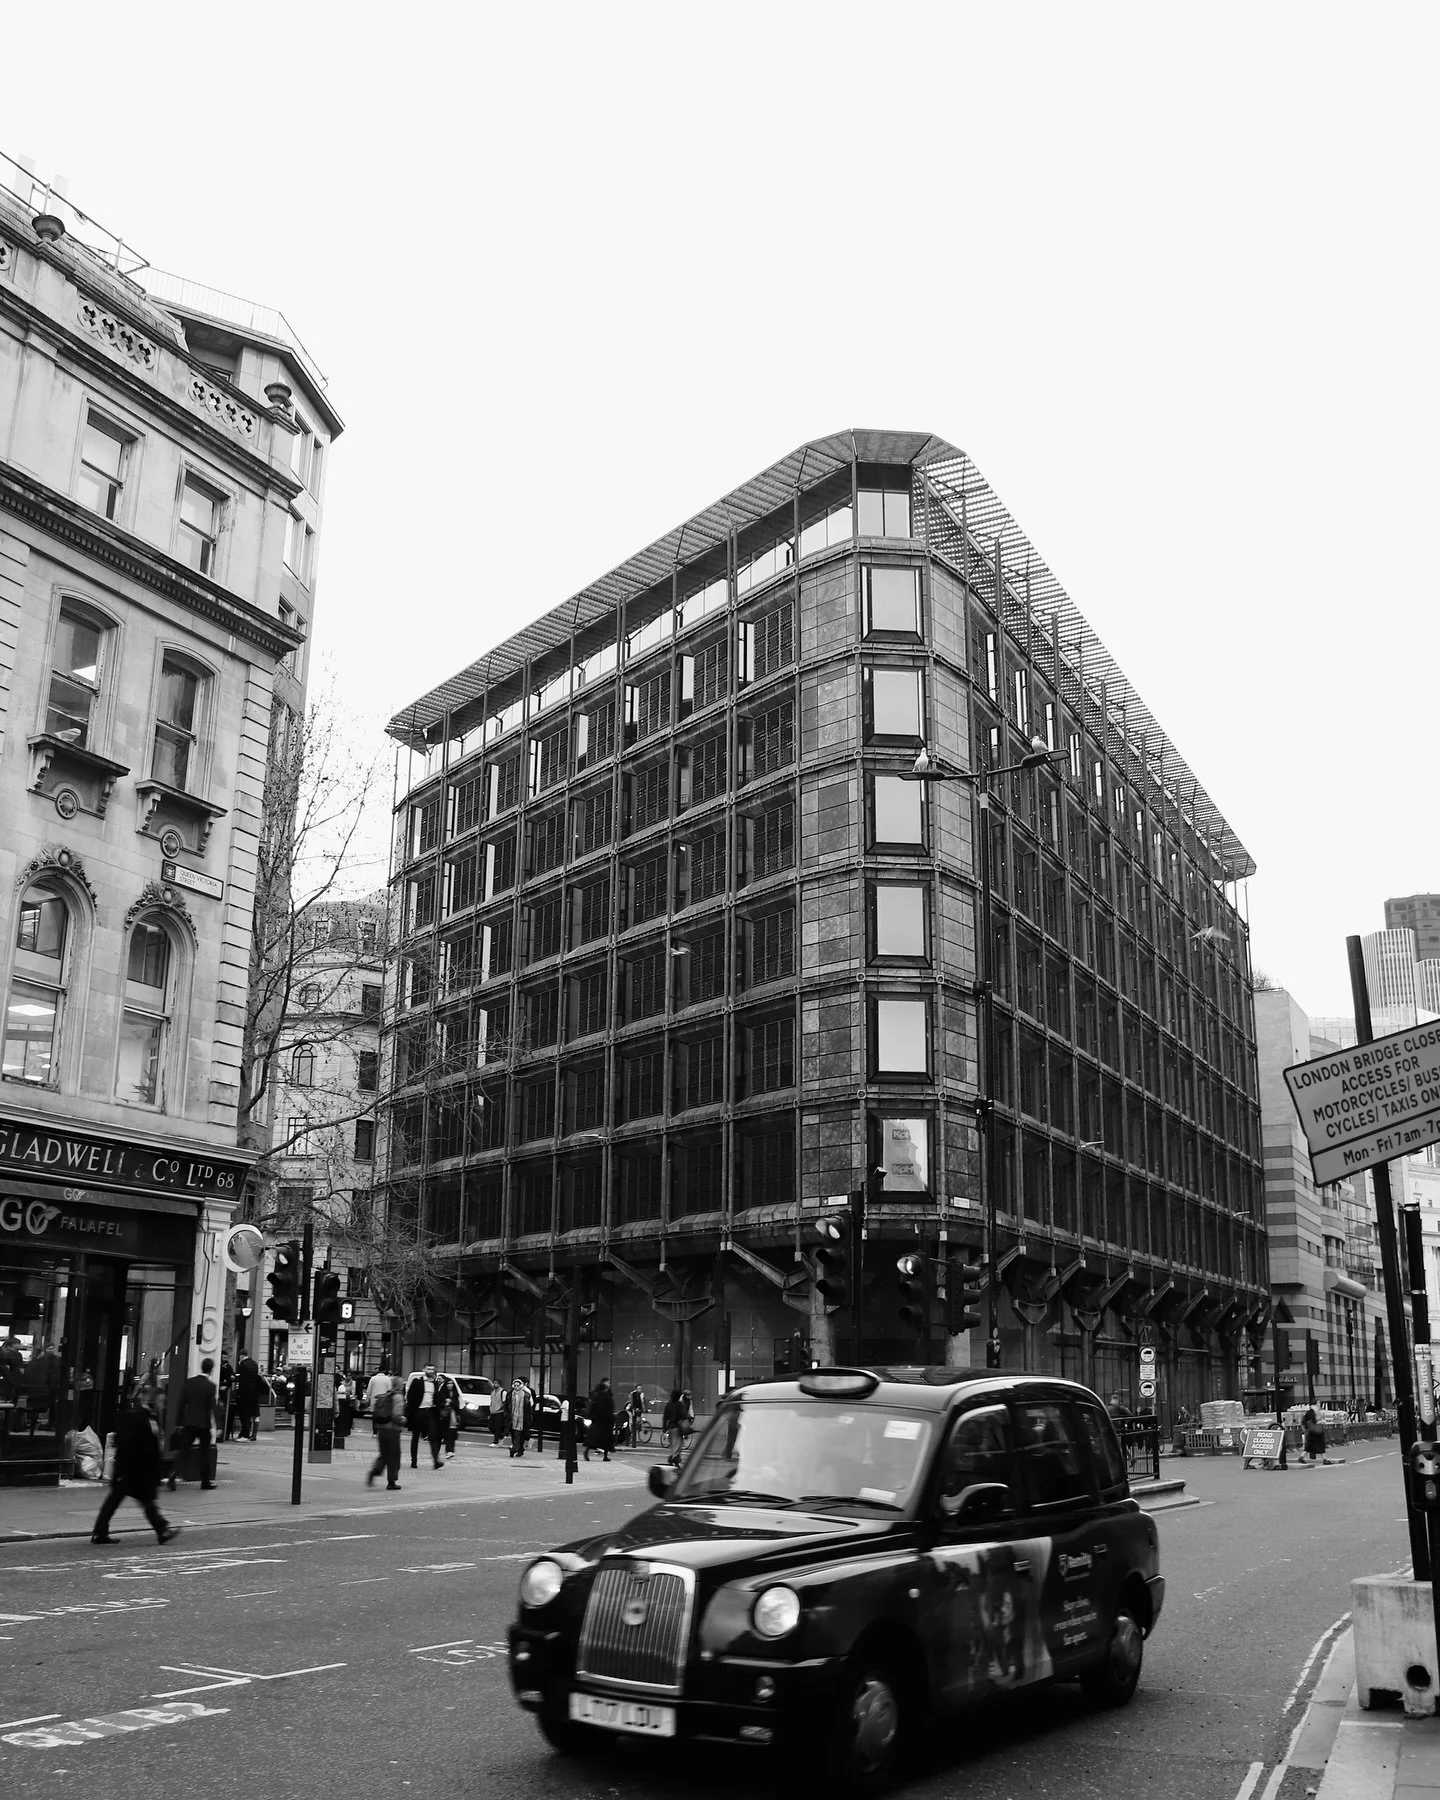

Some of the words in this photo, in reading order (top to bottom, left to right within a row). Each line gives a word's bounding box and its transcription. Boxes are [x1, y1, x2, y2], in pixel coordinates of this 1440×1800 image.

[179, 876, 195, 886] STREET
[180, 869, 197, 880] QUEEN
[197, 874, 218, 888] VICTORIA
[1293, 1059, 1351, 1090] LONDON
[1353, 1043, 1402, 1071] BRIDGE
[1341, 1065, 1392, 1094] ACCESS
[1395, 1055, 1420, 1075] FOR
[1313, 1075, 1411, 1123] MOTORCYCLES/
[1414, 1066, 1440, 1088] BUS
[1326, 1106, 1379, 1138] CYCLES/
[1381, 1094, 1419, 1119] TAXIS
[1421, 1085, 1440, 1104] ON
[1343, 1147, 1370, 1166] Mon
[1376, 1135, 1393, 1153] Fri
[217, 1172, 235, 1189] 68
[60, 1216, 123, 1237] FALAFEL
[1420, 1363, 1429, 1389] butts
[1423, 1394, 1433, 1416] gum
